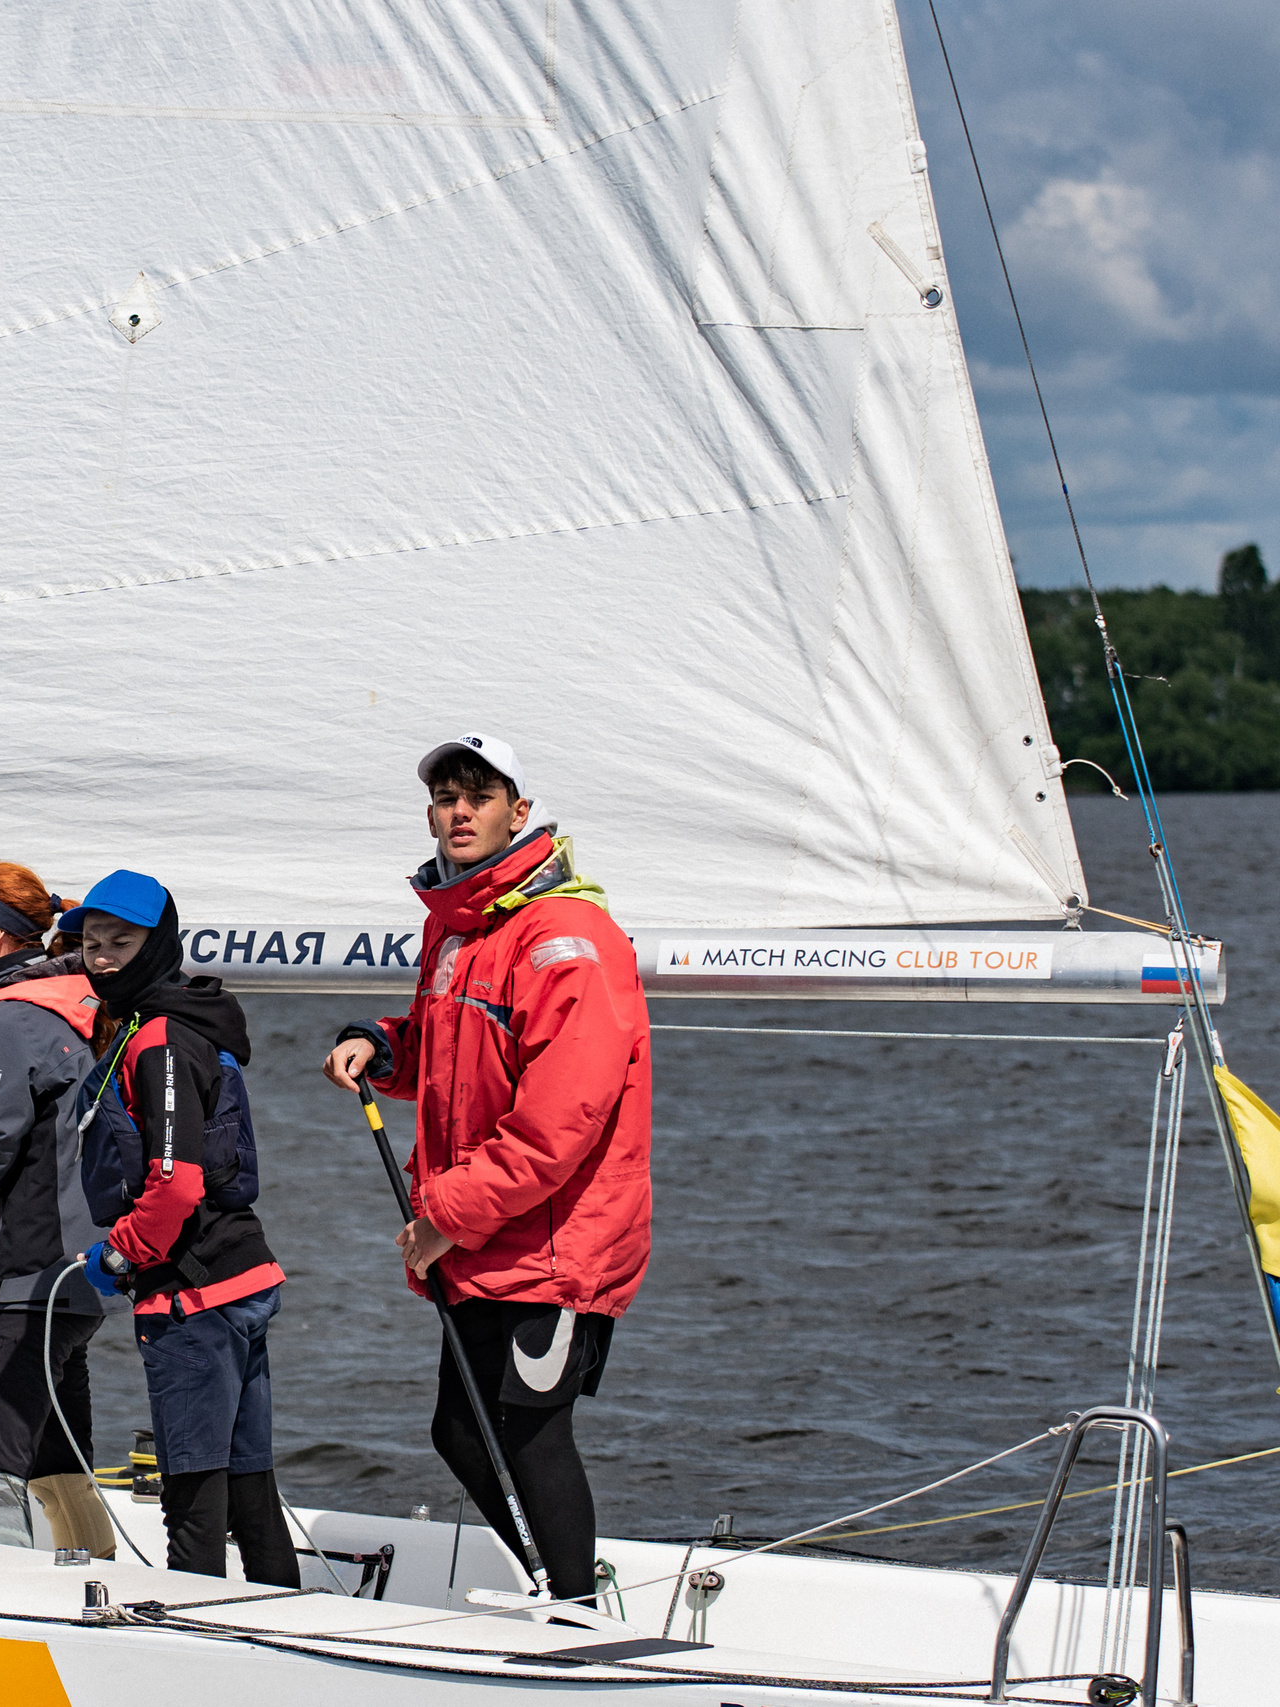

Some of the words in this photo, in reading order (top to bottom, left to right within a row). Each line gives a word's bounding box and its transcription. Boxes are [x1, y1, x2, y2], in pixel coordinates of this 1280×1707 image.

[342, 933, 422, 967] АК
[702, 949, 786, 966] MATCH
[794, 949, 887, 968] RACING
[896, 950, 958, 969] CLUB
[970, 951, 1038, 970] TOUR
